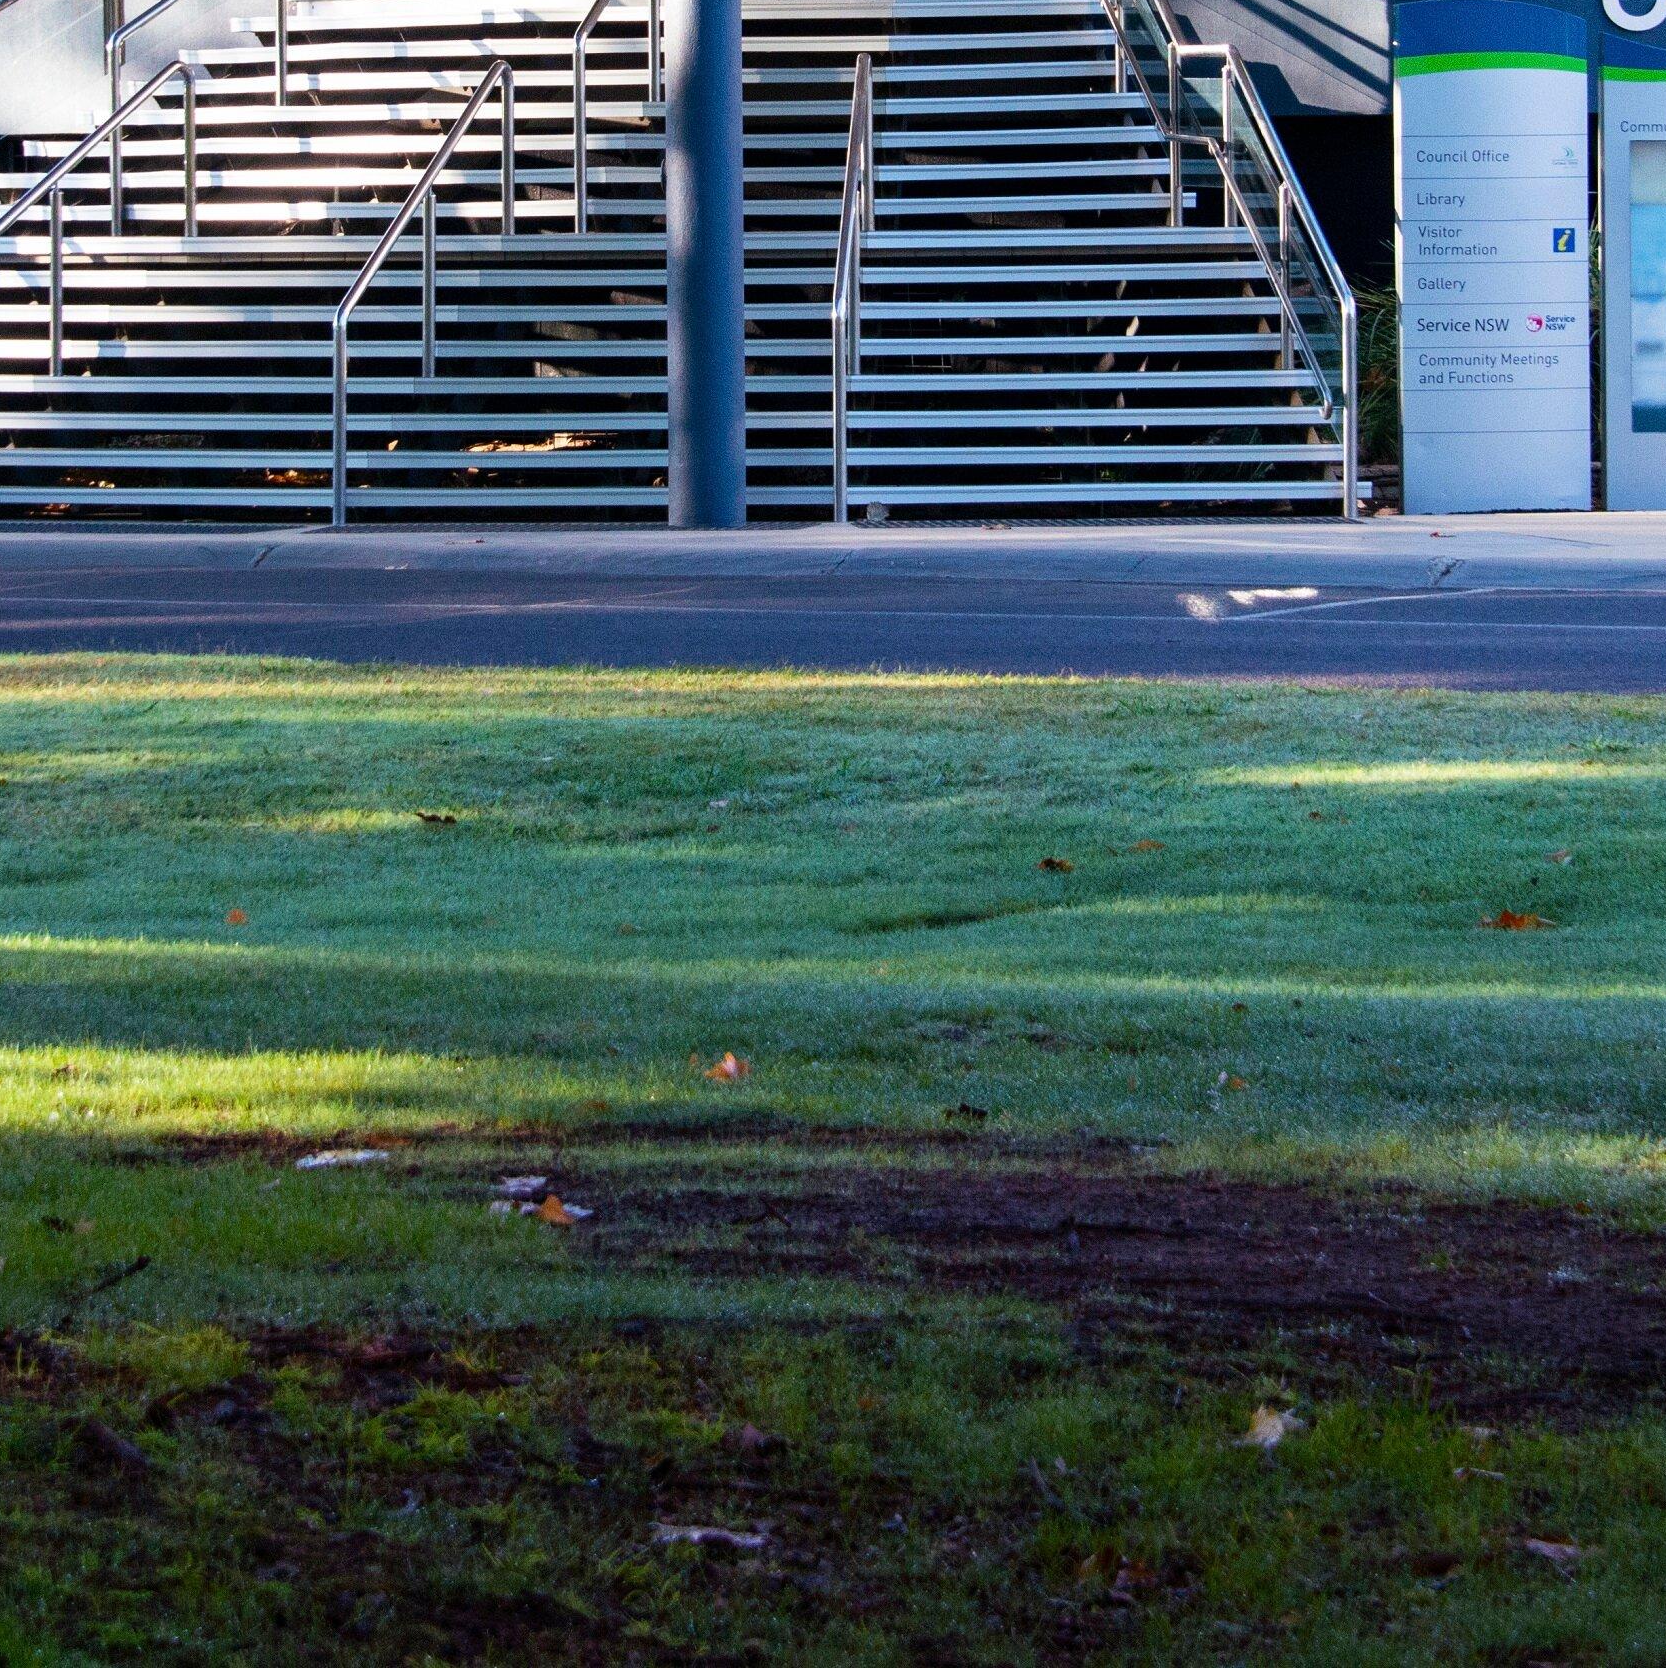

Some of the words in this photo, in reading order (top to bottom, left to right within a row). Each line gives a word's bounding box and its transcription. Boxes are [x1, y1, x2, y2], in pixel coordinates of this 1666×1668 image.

[1416, 150, 1468, 163] Council
[1471, 149, 1510, 163] Office
[1416, 193, 1466, 208] Library
[1418, 225, 1463, 238] Visitor
[1418, 243, 1498, 256] Information
[1418, 277, 1467, 292] Gallery
[1417, 317, 1471, 332] Service
[1474, 318, 1510, 332] NSW
[1545, 314, 1576, 323] Service
[1545, 322, 1567, 331] NSW
[1419, 353, 1497, 370] Community
[1500, 352, 1560, 369] Meetings
[1419, 371, 1445, 384] and
[1448, 370, 1515, 384] Functions
